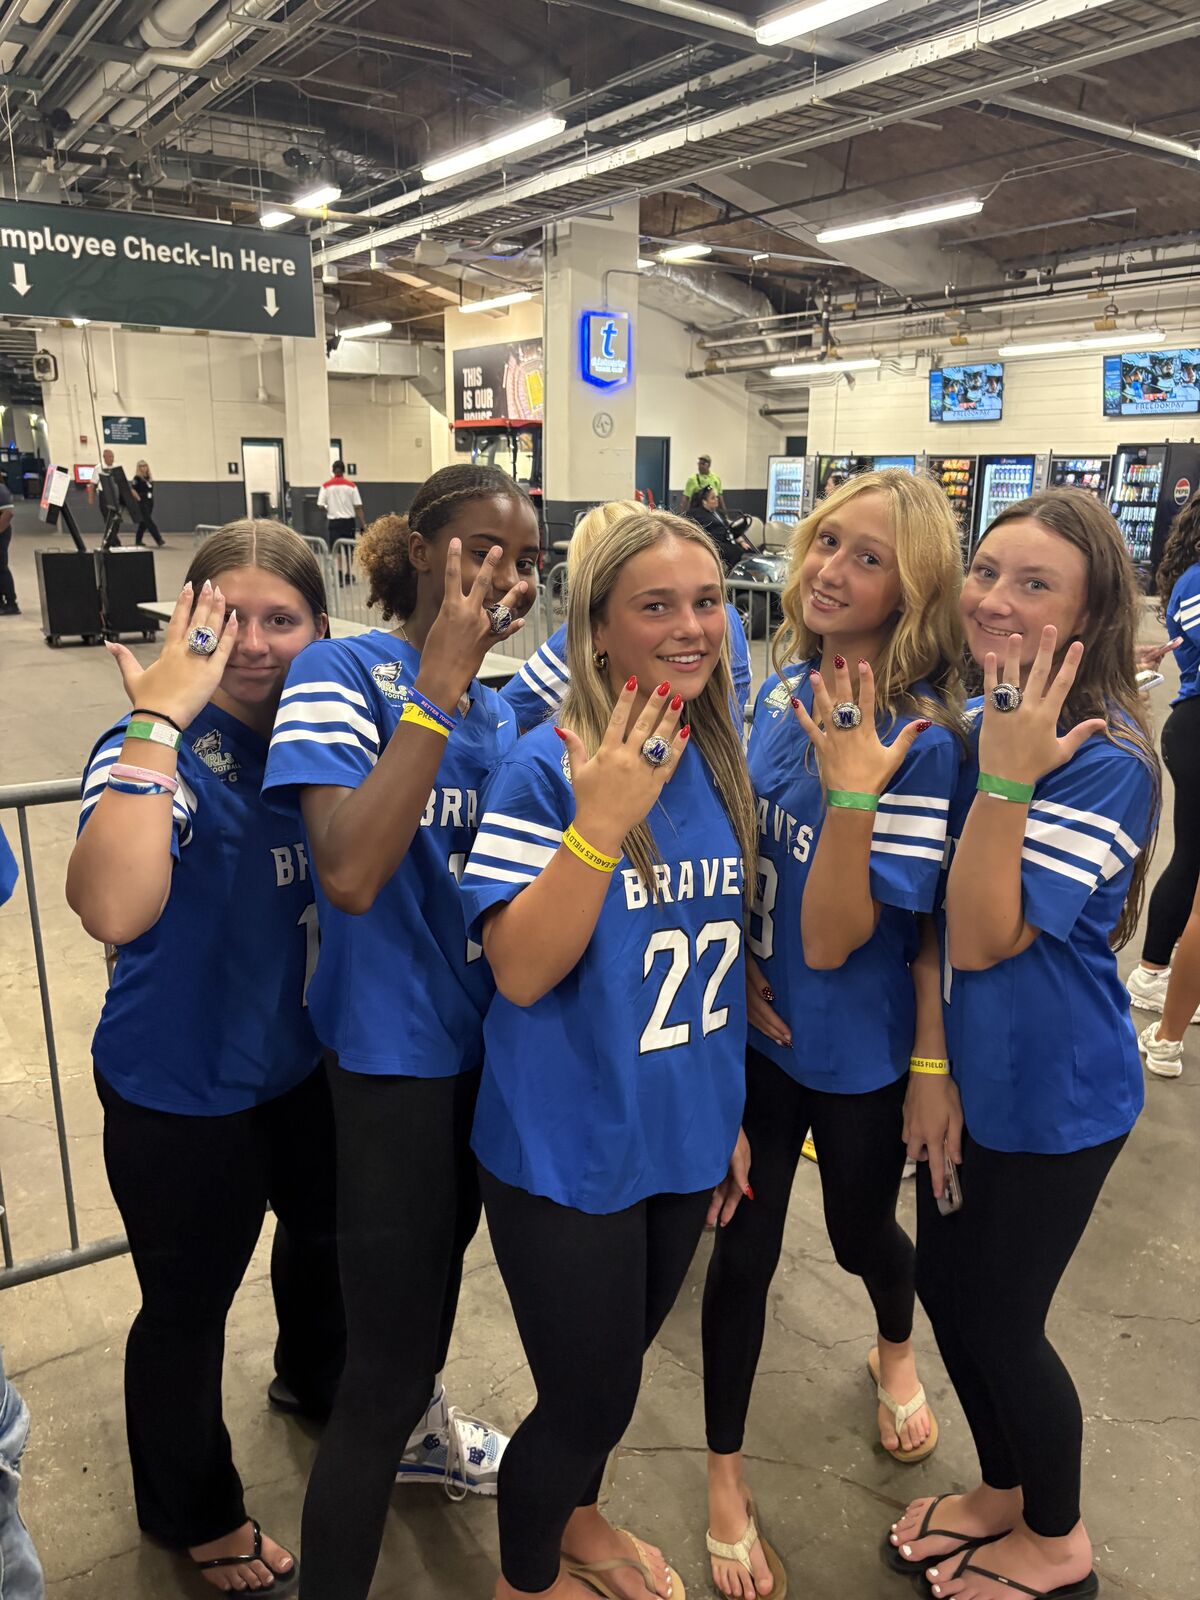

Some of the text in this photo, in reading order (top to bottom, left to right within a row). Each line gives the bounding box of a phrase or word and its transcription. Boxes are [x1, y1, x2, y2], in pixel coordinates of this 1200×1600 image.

[123, 235, 234, 270] Check-In
[240, 249, 296, 276] Here
[463, 366, 483, 388] THIS
[463, 388, 493, 410] IS OUR
[568, 835, 586, 853] FIELD
[584, 850, 612, 868] EAGLES
[620, 857, 745, 910] BRAVE
[638, 918, 742, 1056] 22
[925, 1061, 944, 1069] FIELD
